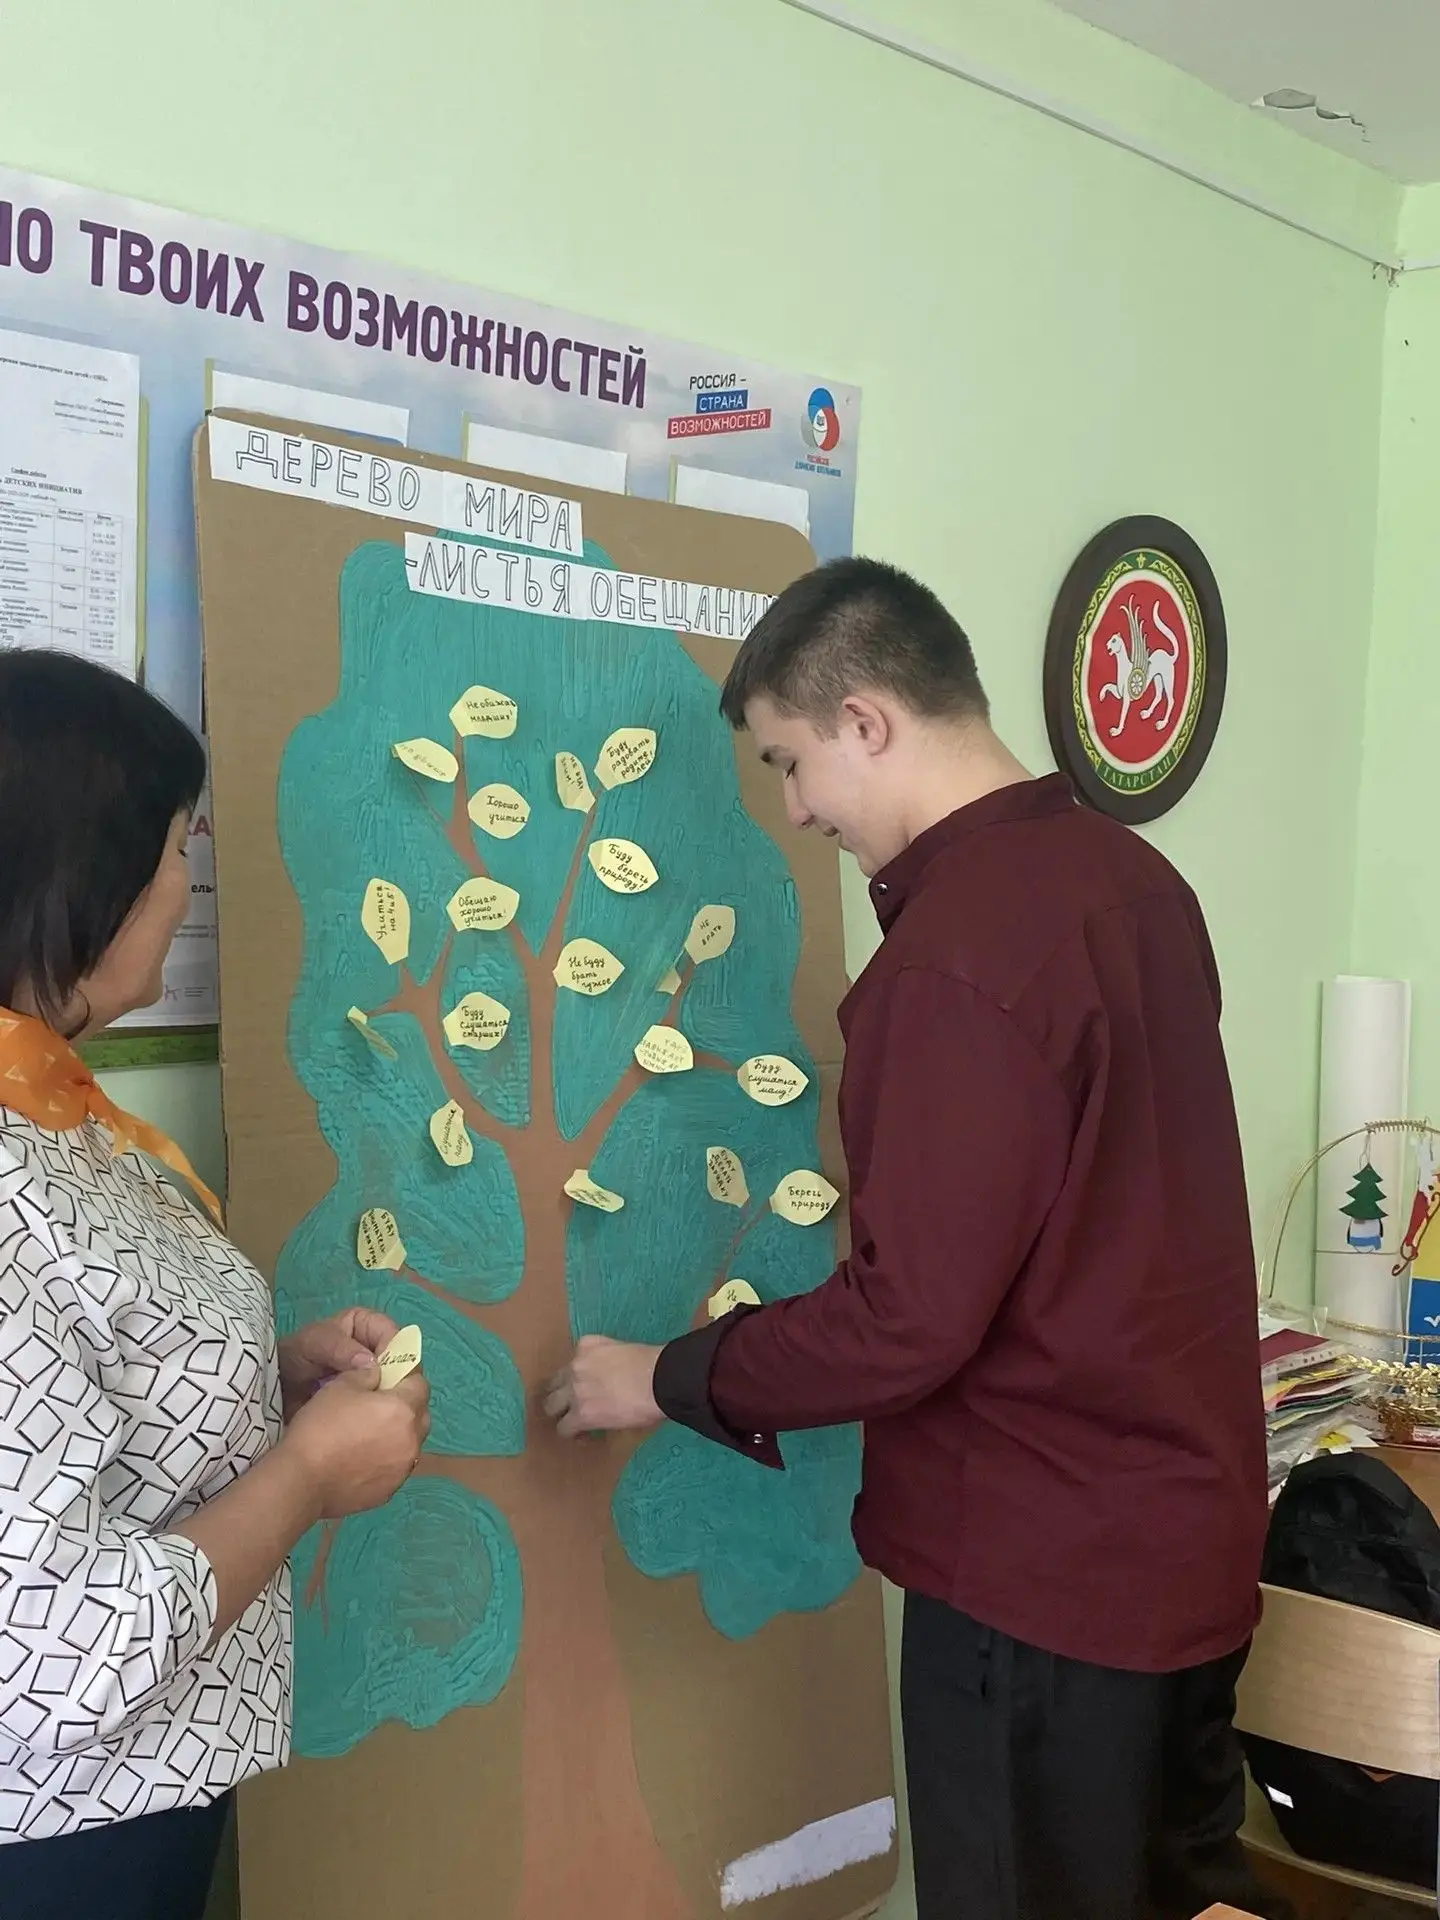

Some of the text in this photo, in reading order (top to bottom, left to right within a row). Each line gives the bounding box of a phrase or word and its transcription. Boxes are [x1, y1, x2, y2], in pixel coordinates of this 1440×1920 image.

[79, 218, 265, 323] ТВОИХ
[287, 270, 646, 409] ВОЗМОЖНОСТЕЙ
[689, 373, 736, 390] РОССИЯ
[699, 394, 744, 411] СТРАНА
[670, 411, 766, 436] ВОЗМОЖНОСТЕЙ
[236, 430, 573, 551] ДЕРЕВО МИРА
[1103, 756, 1171, 788] ТАТАРСТАН
[487, 795, 520, 810] Хорошо
[488, 812, 527, 825] учиться
[608, 843, 633, 864] Буду
[599, 865, 644, 891] природу!
[458, 895, 497, 908] Обещаю
[460, 905, 492, 917] хорошо
[568, 956, 605, 969] Не буду
[572, 970, 598, 984] брать
[581, 978, 612, 993] чужое
[461, 1005, 485, 1021] Буду
[753, 1058, 782, 1074] Буду
[791, 1199, 832, 1211] природу
